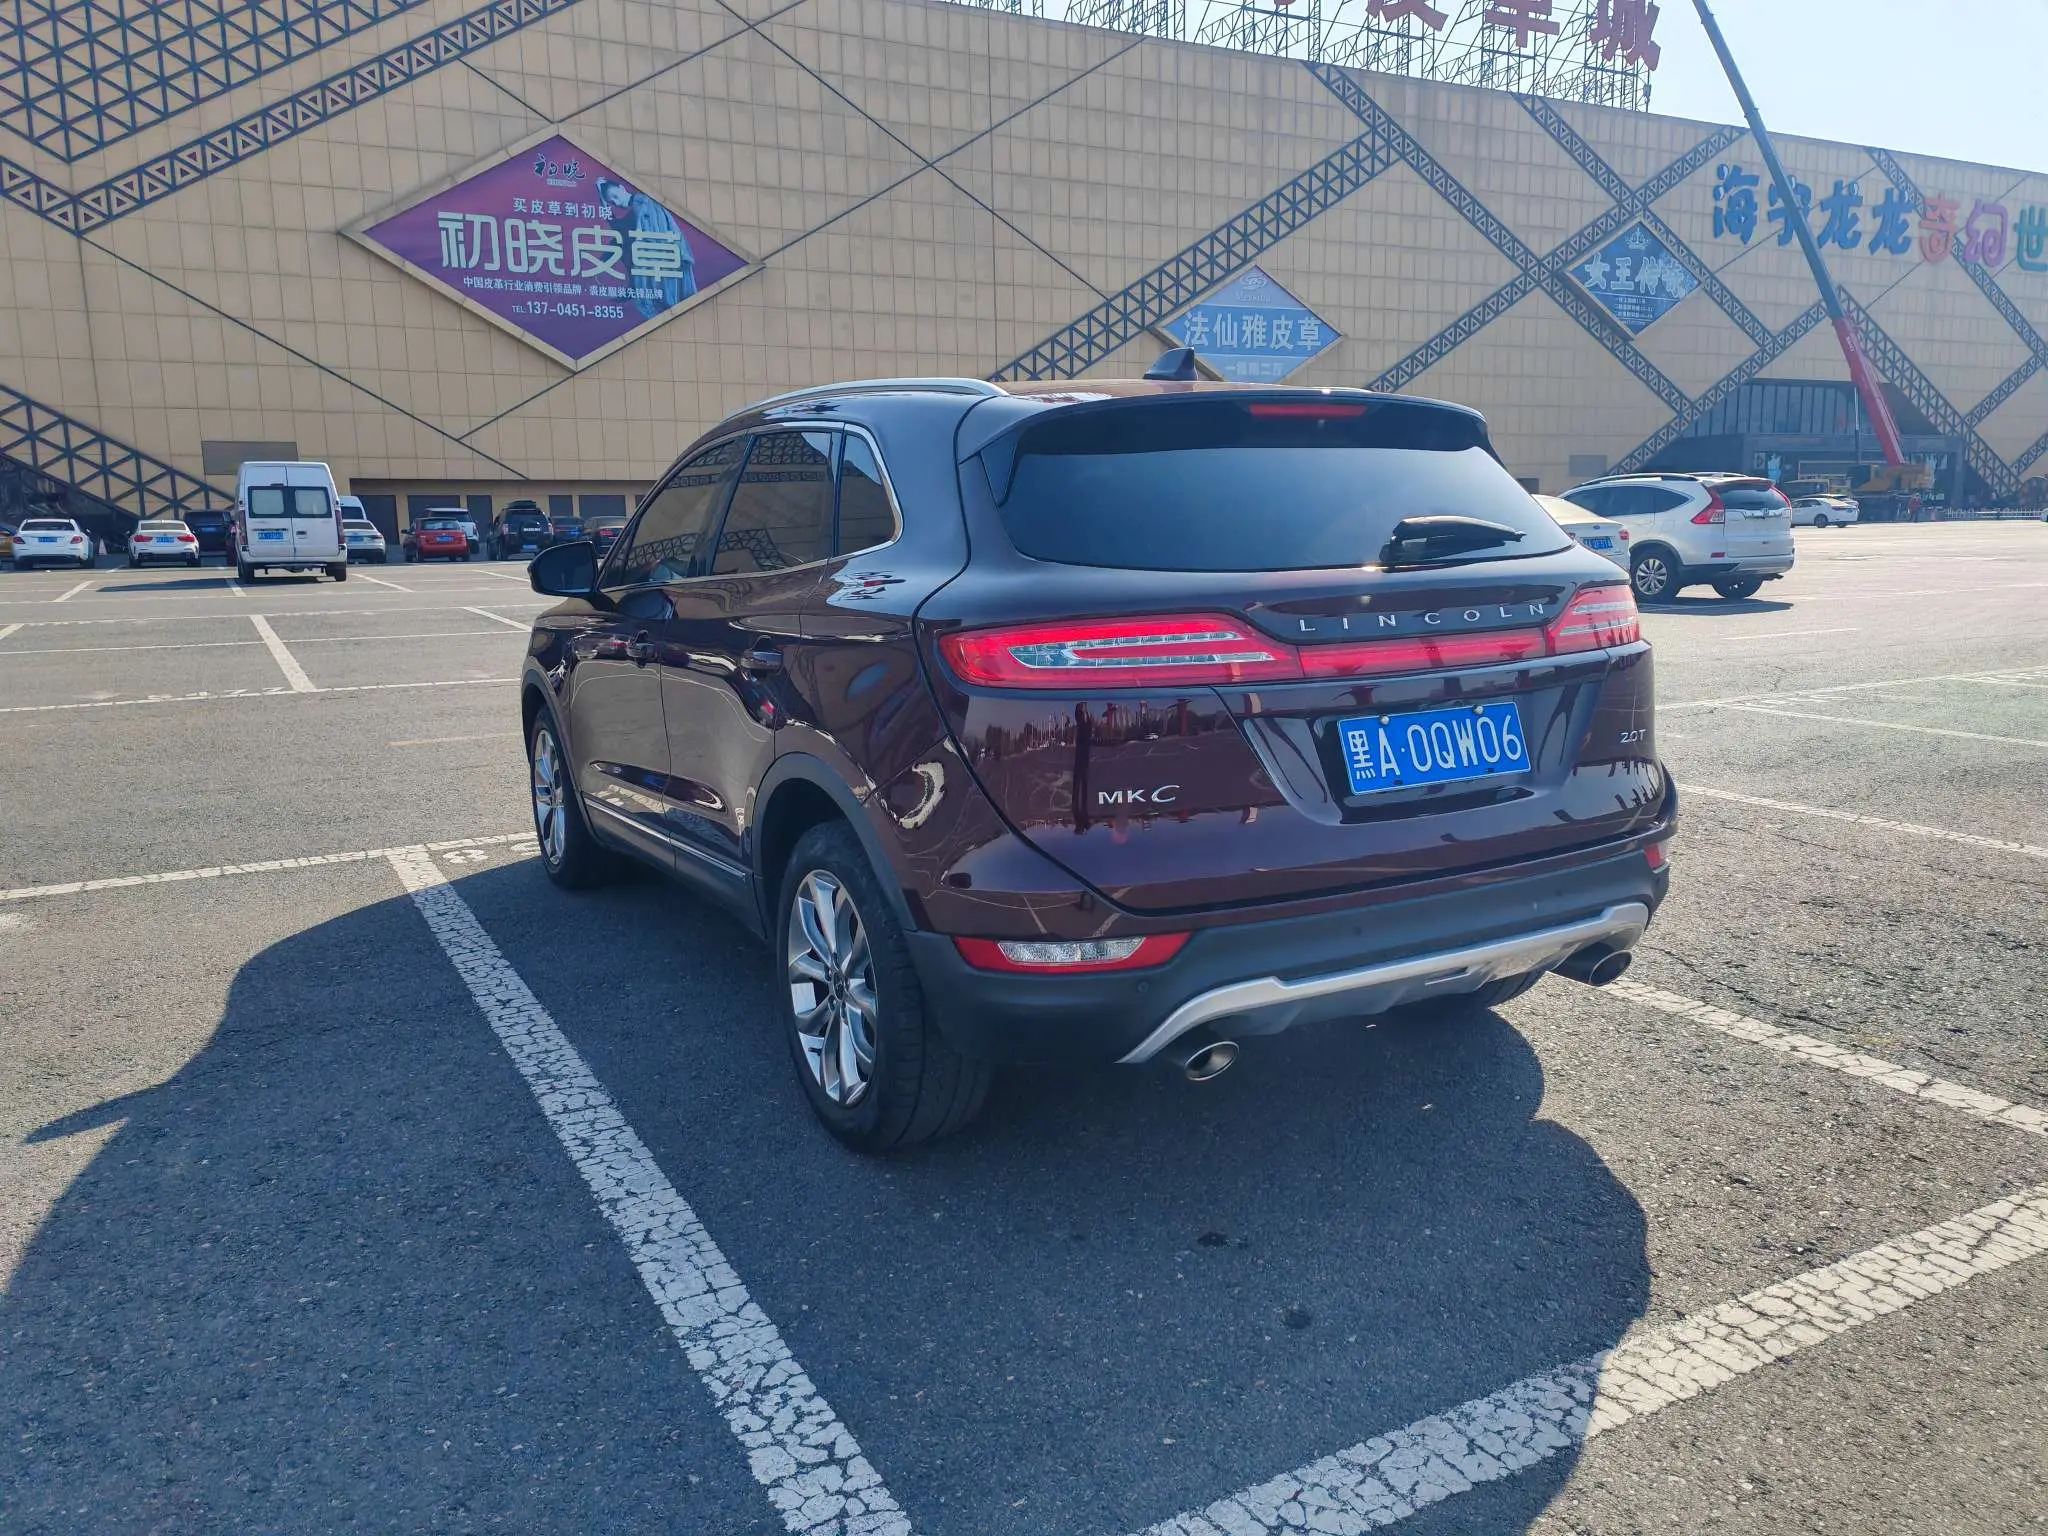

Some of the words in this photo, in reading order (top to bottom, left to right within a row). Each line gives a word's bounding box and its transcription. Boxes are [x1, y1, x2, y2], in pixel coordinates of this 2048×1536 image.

[513, 198, 613, 220] 买皮草到初晓
[438, 211, 683, 282] 初晓皮草
[527, 301, 624, 319] 137-0451-8355
[1183, 311, 1321, 350] 法仙雅皮草
[1299, 603, 1545, 632] LINCOLN
[1098, 785, 1181, 804] MKC
